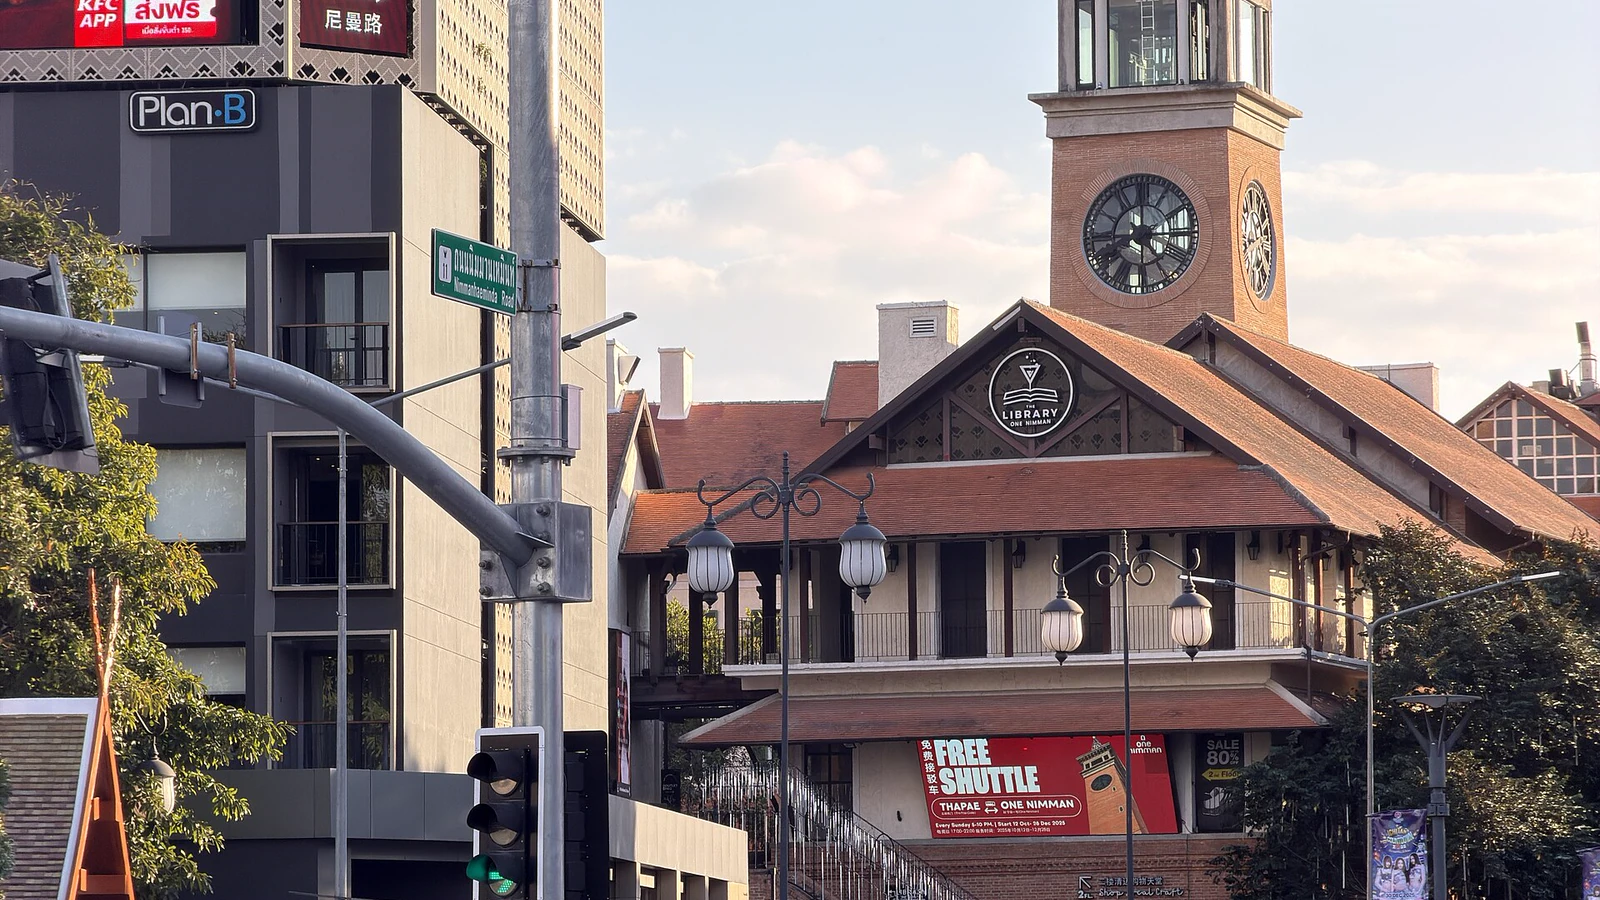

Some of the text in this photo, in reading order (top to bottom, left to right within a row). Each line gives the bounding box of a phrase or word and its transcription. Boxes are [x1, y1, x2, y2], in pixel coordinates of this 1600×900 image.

[77, 0, 118, 11] KFC
[135, 0, 200, 19] สงฟร
[79, 13, 117, 28] APP
[325, 9, 382, 35] 尼曼路
[454, 276, 514, 309] Nimmanhaeminda Road
[1002, 408, 1058, 420] LIBRARY
[1025, 418, 1051, 426] NIMMAN
[1207, 739, 1240, 750] SALE
[934, 739, 992, 766] FREE
[921, 741, 939, 795] 免费接驳车
[939, 766, 1040, 794] SHUTTLE
[939, 802, 981, 812] THAPAE
[1000, 799, 1074, 810] ONE NIMMAN
[951, 821, 971, 829] Sunday
[1099, 888, 1124, 899] Shop
[1155, 887, 1184, 897] Craft
